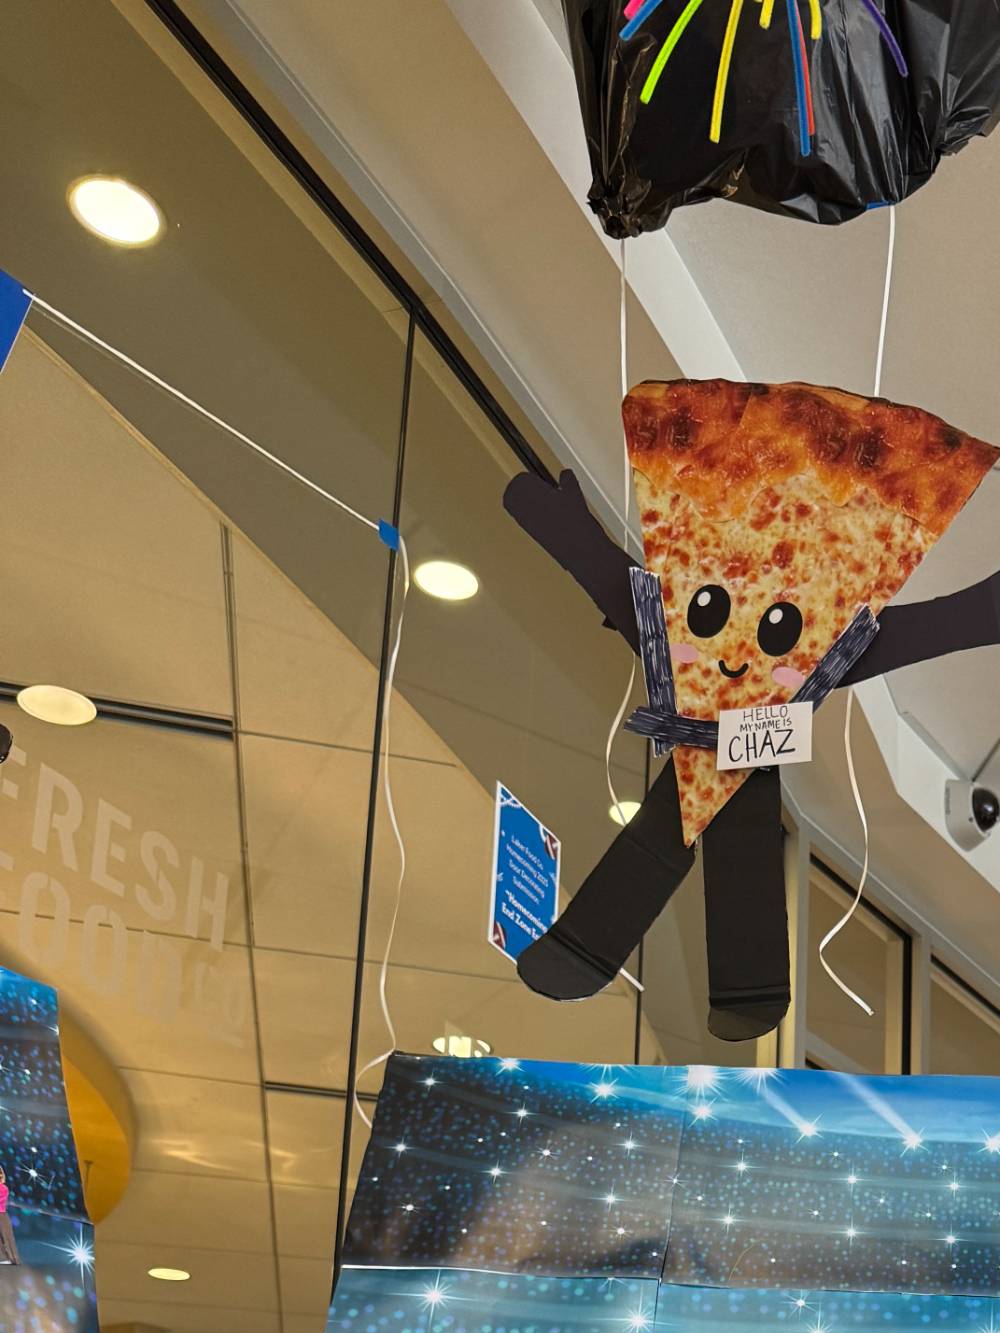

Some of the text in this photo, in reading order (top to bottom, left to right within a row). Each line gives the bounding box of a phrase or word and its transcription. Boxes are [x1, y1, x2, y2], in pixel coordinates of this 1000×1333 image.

[740, 718, 793, 732] MY NAME IS
[743, 705, 788, 722] HELLO
[728, 728, 796, 762] CHAZ
[502, 901, 515, 922] End
[514, 912, 532, 938] Zone
[0, 850, 183, 1024] OOD
